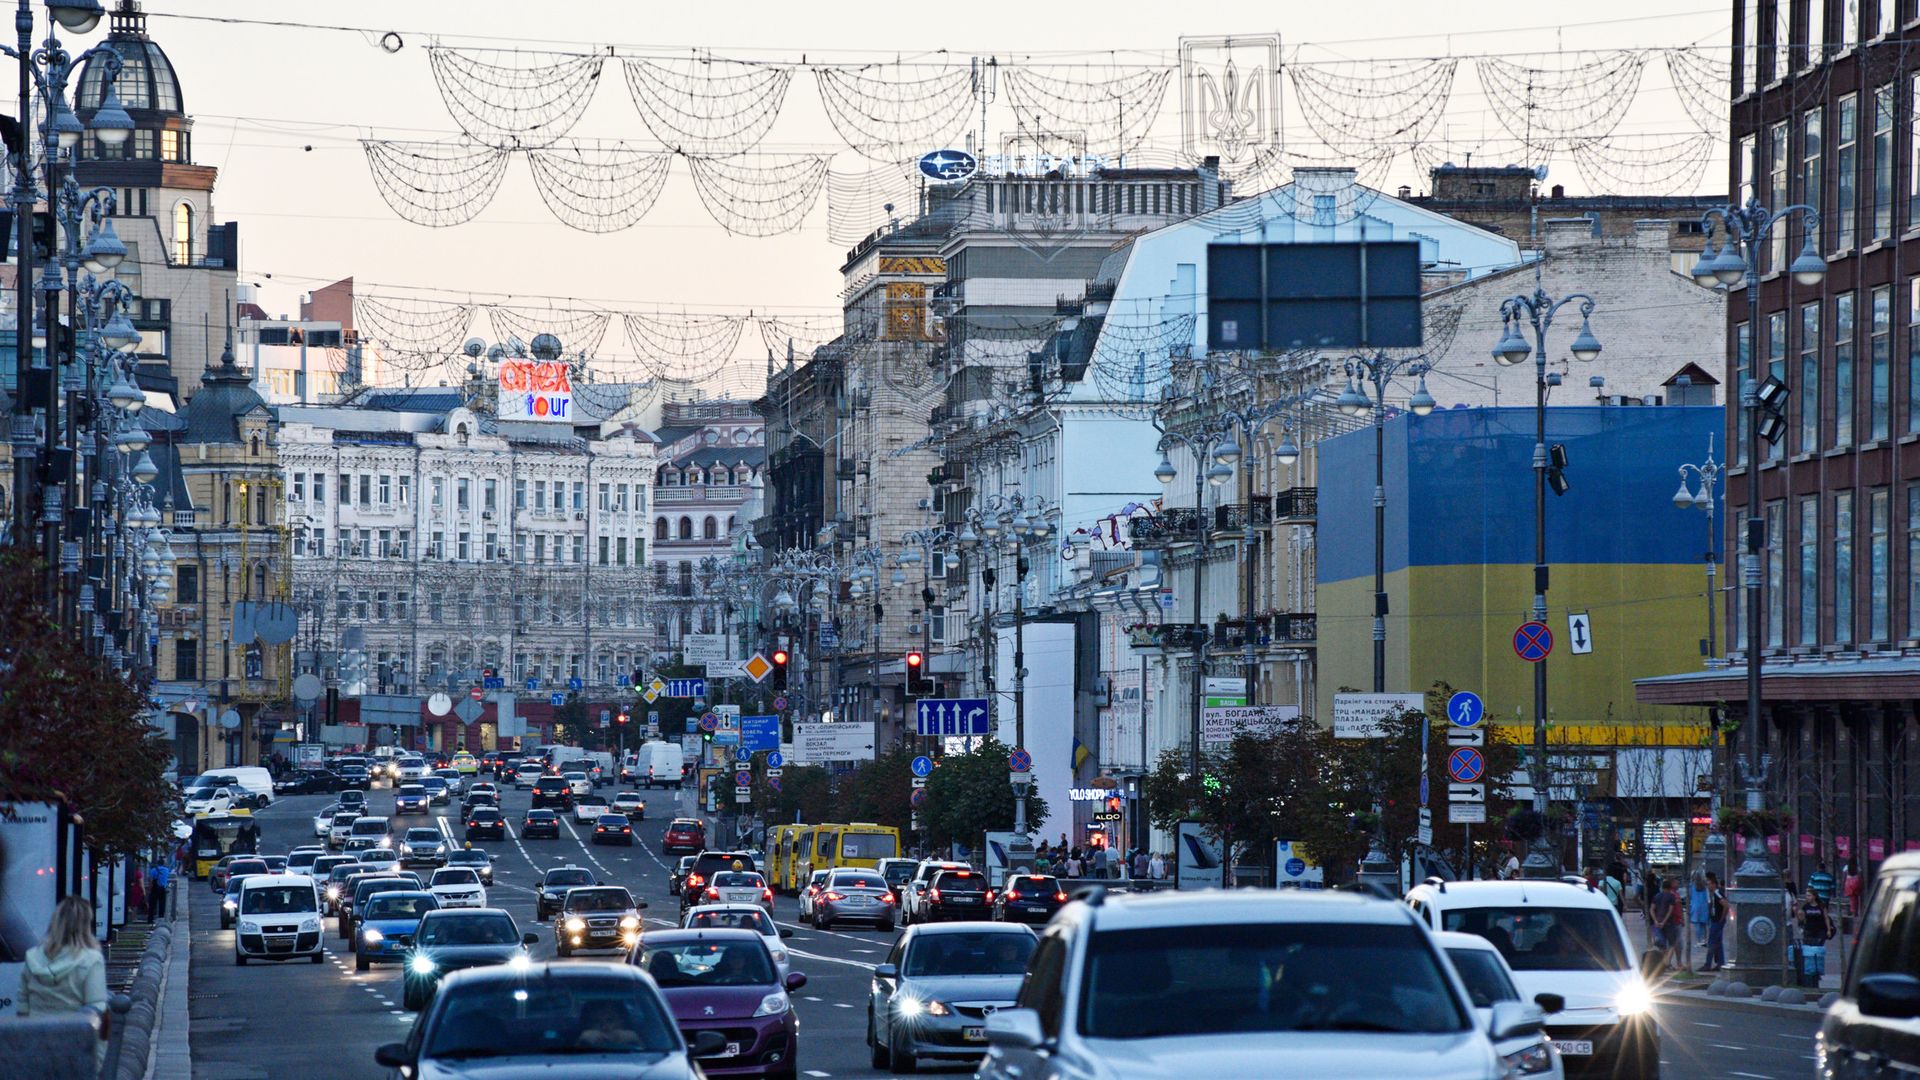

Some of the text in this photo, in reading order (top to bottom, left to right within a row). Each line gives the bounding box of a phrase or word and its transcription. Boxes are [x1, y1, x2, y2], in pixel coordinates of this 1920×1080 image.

[527, 394, 569, 417] tour
[1205, 711, 1222, 719] вул.
[1069, 788, 1085, 800] YOLO
